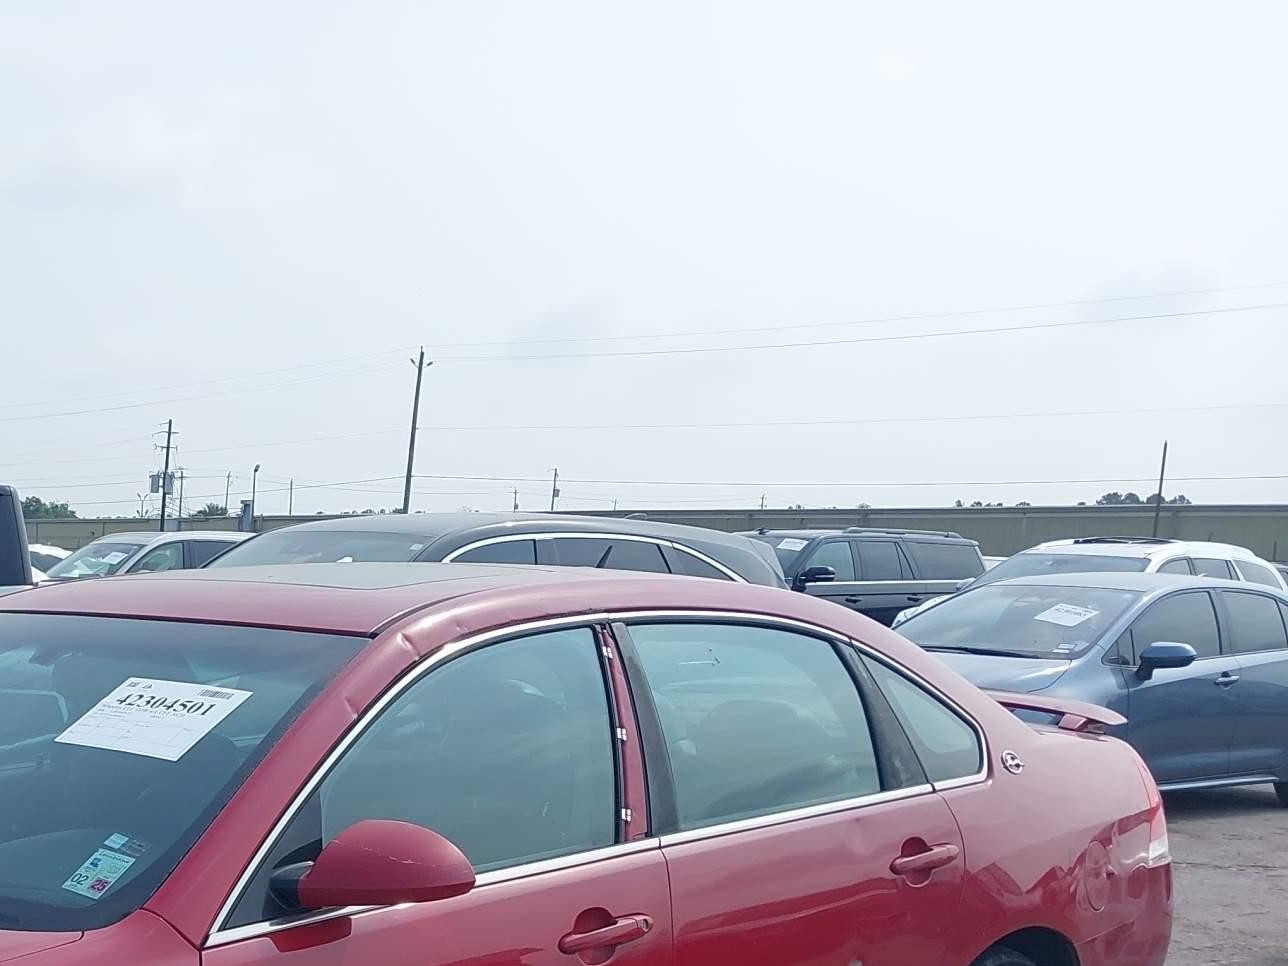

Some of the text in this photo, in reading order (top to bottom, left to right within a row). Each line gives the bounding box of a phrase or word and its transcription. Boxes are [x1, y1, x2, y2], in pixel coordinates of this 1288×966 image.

[116, 693, 216, 716] 42304501
[71, 873, 89, 885] 02
[91, 879, 109, 892] 25
